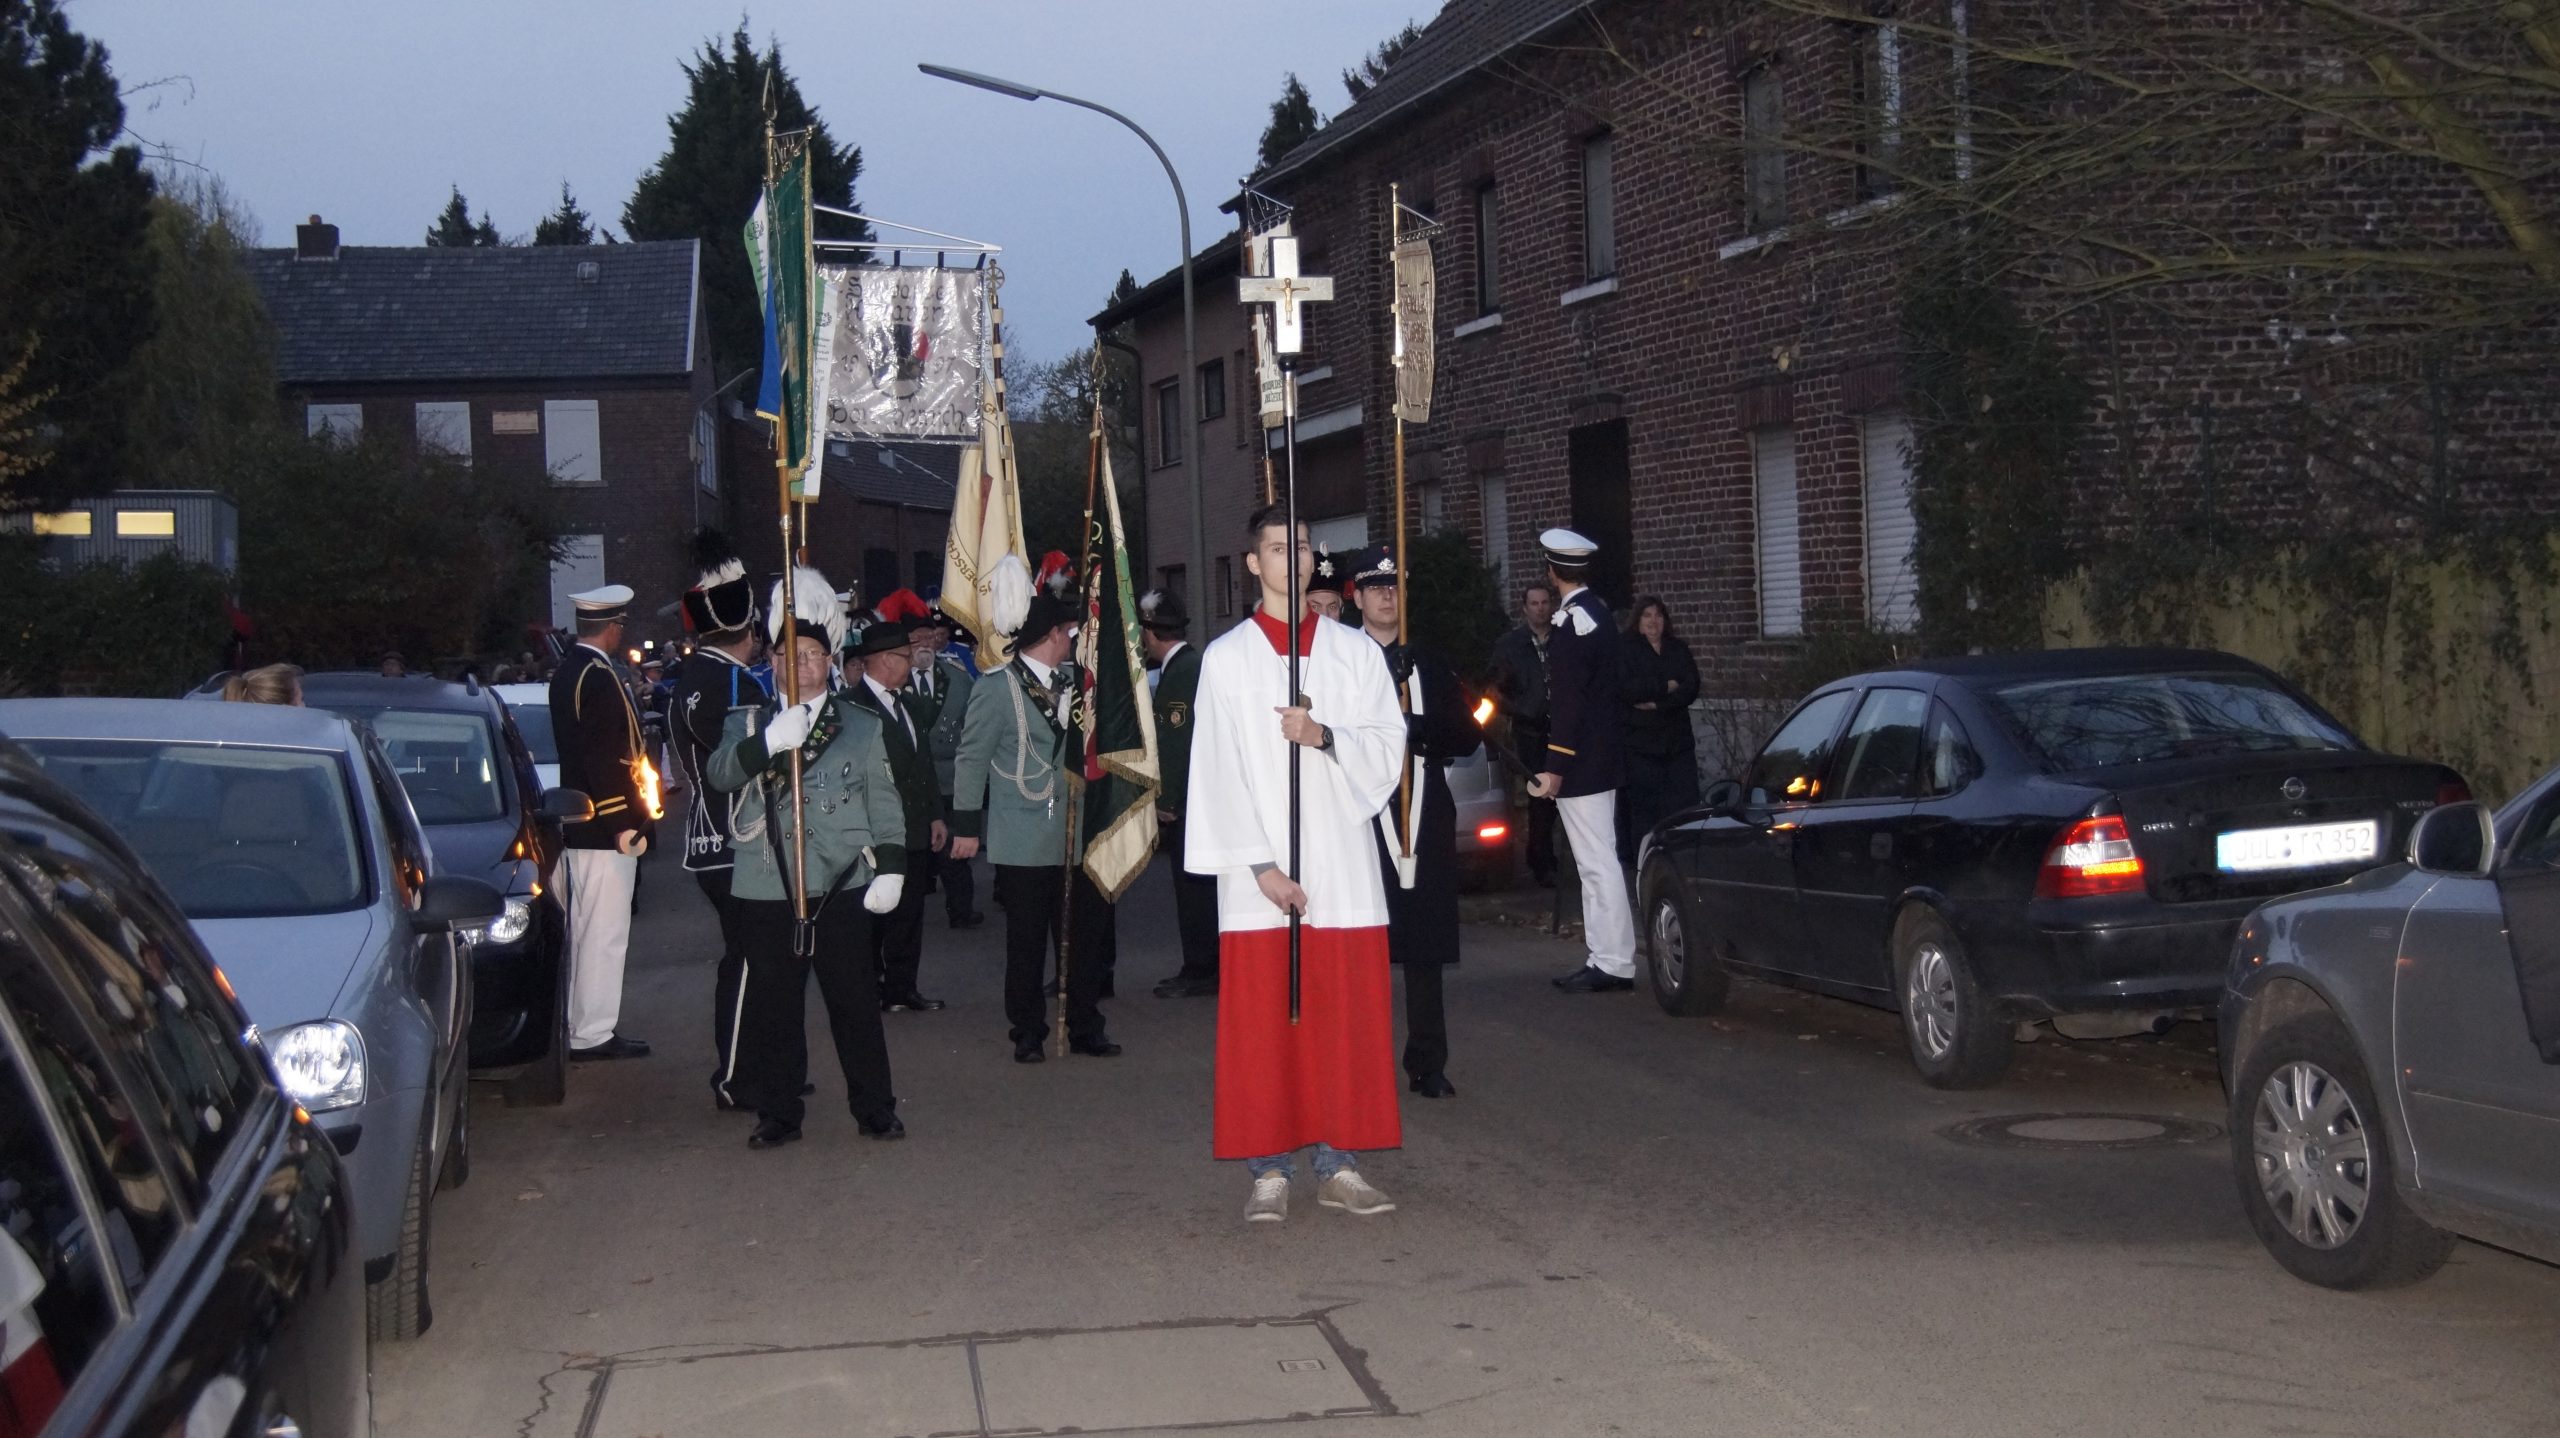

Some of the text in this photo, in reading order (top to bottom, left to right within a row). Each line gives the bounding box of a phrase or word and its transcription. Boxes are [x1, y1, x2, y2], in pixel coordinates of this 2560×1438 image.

[2142, 821, 2176, 832] OPEL
[2298, 830, 2323, 857] TR
[2333, 826, 2371, 853] 352
